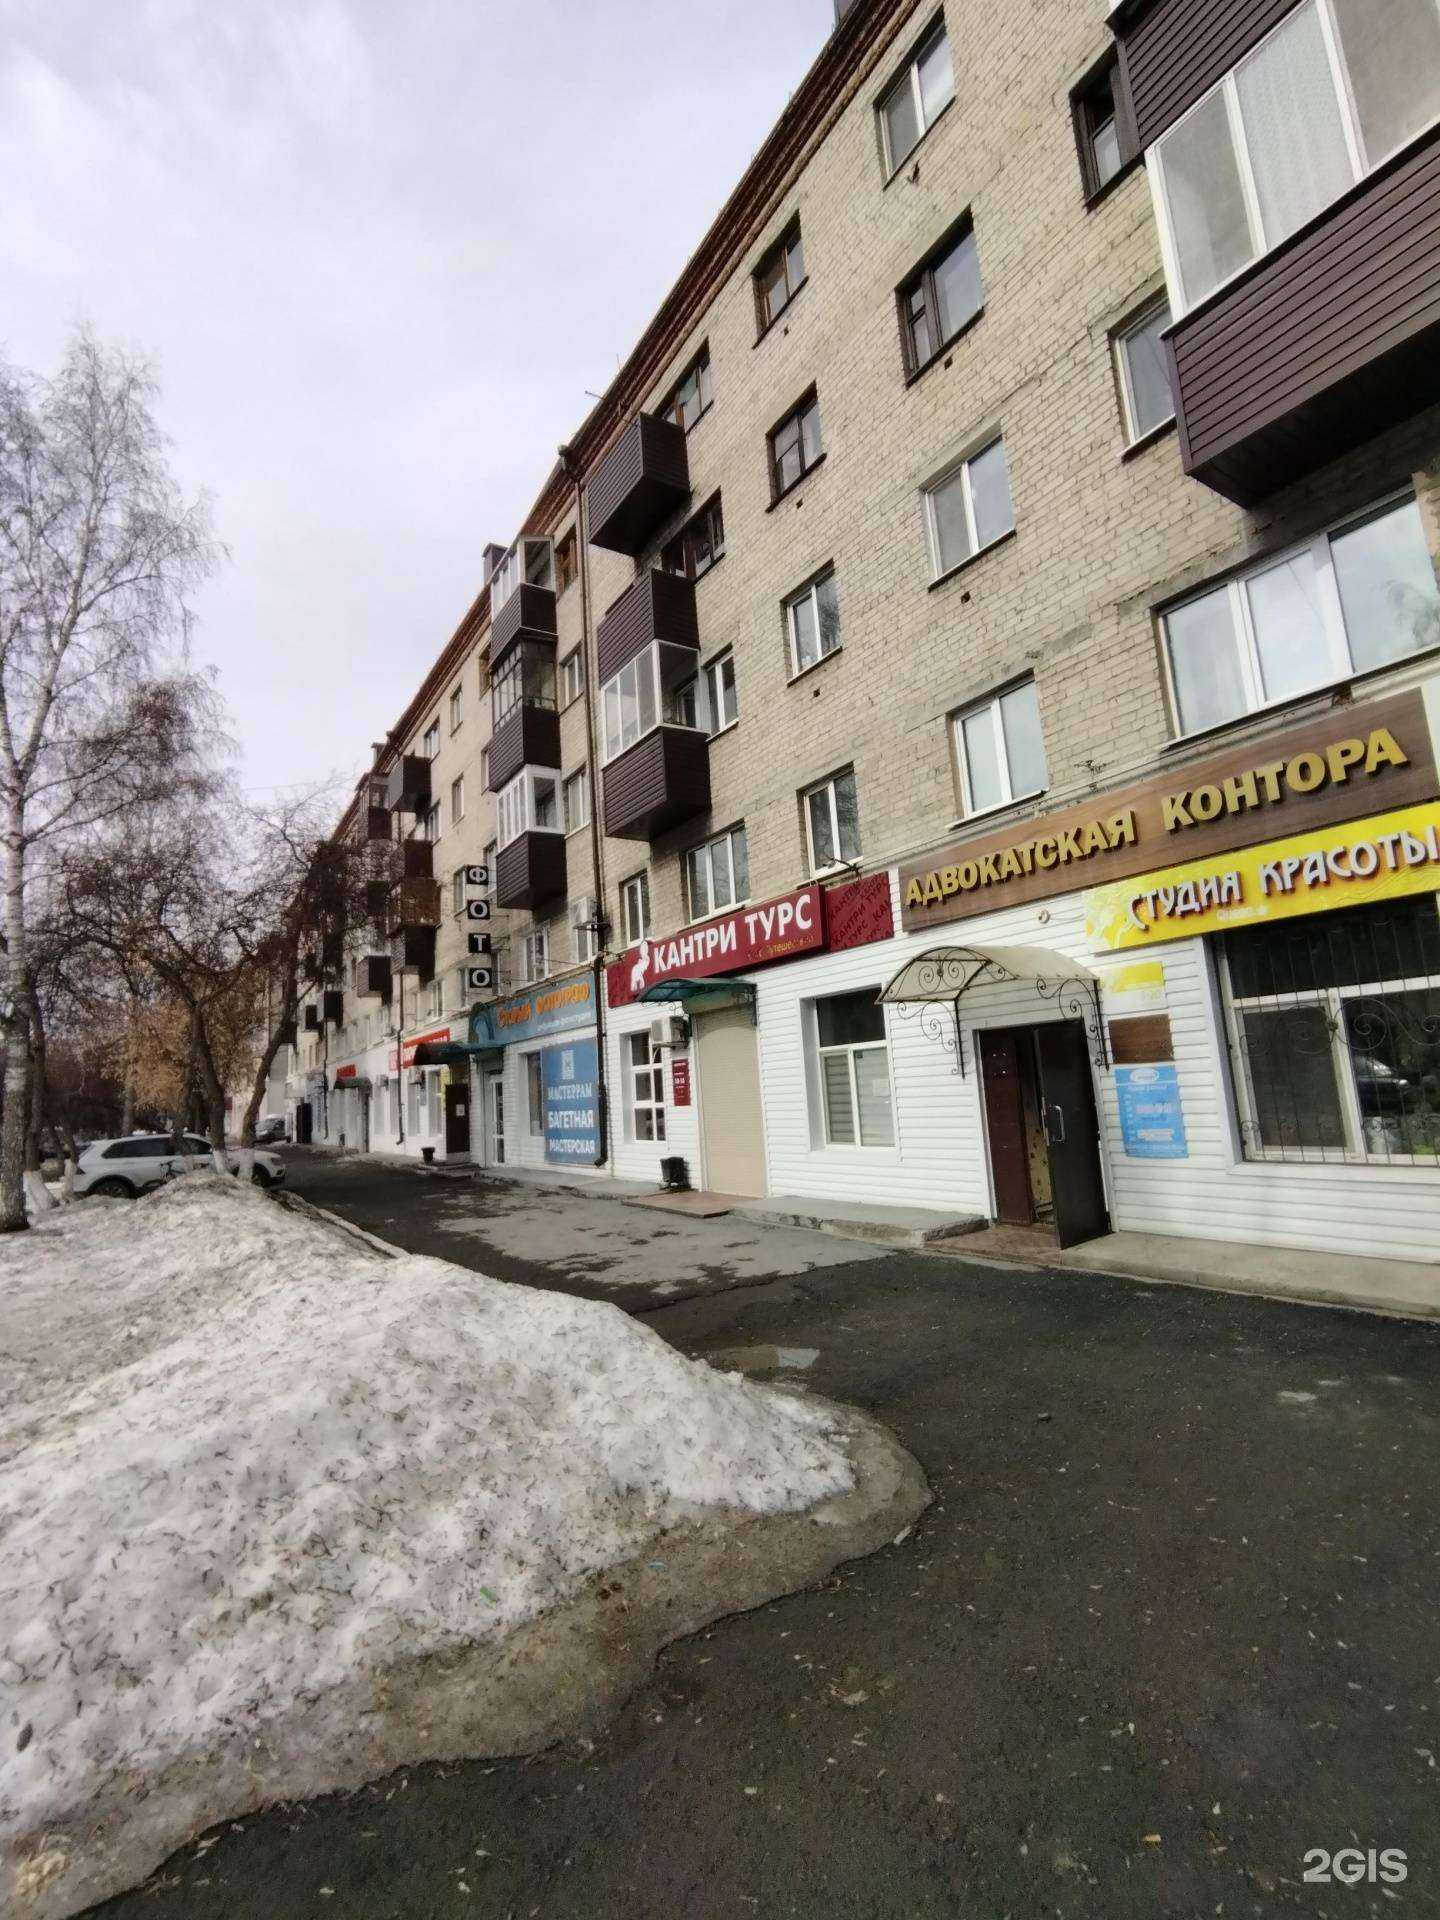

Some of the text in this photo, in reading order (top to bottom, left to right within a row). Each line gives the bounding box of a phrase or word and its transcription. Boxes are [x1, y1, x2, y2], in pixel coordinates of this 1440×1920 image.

[905, 727, 1409, 907] АДВОКАТСКАЯ КОНТОРА
[468, 866, 490, 987] ФОТО
[1127, 822, 1440, 930] СТУДИЯ КРАСОТЫ
[653, 894, 813, 974] КАНТРИ ТУРС
[548, 1110, 593, 1128] БАГЕТНАЯ
